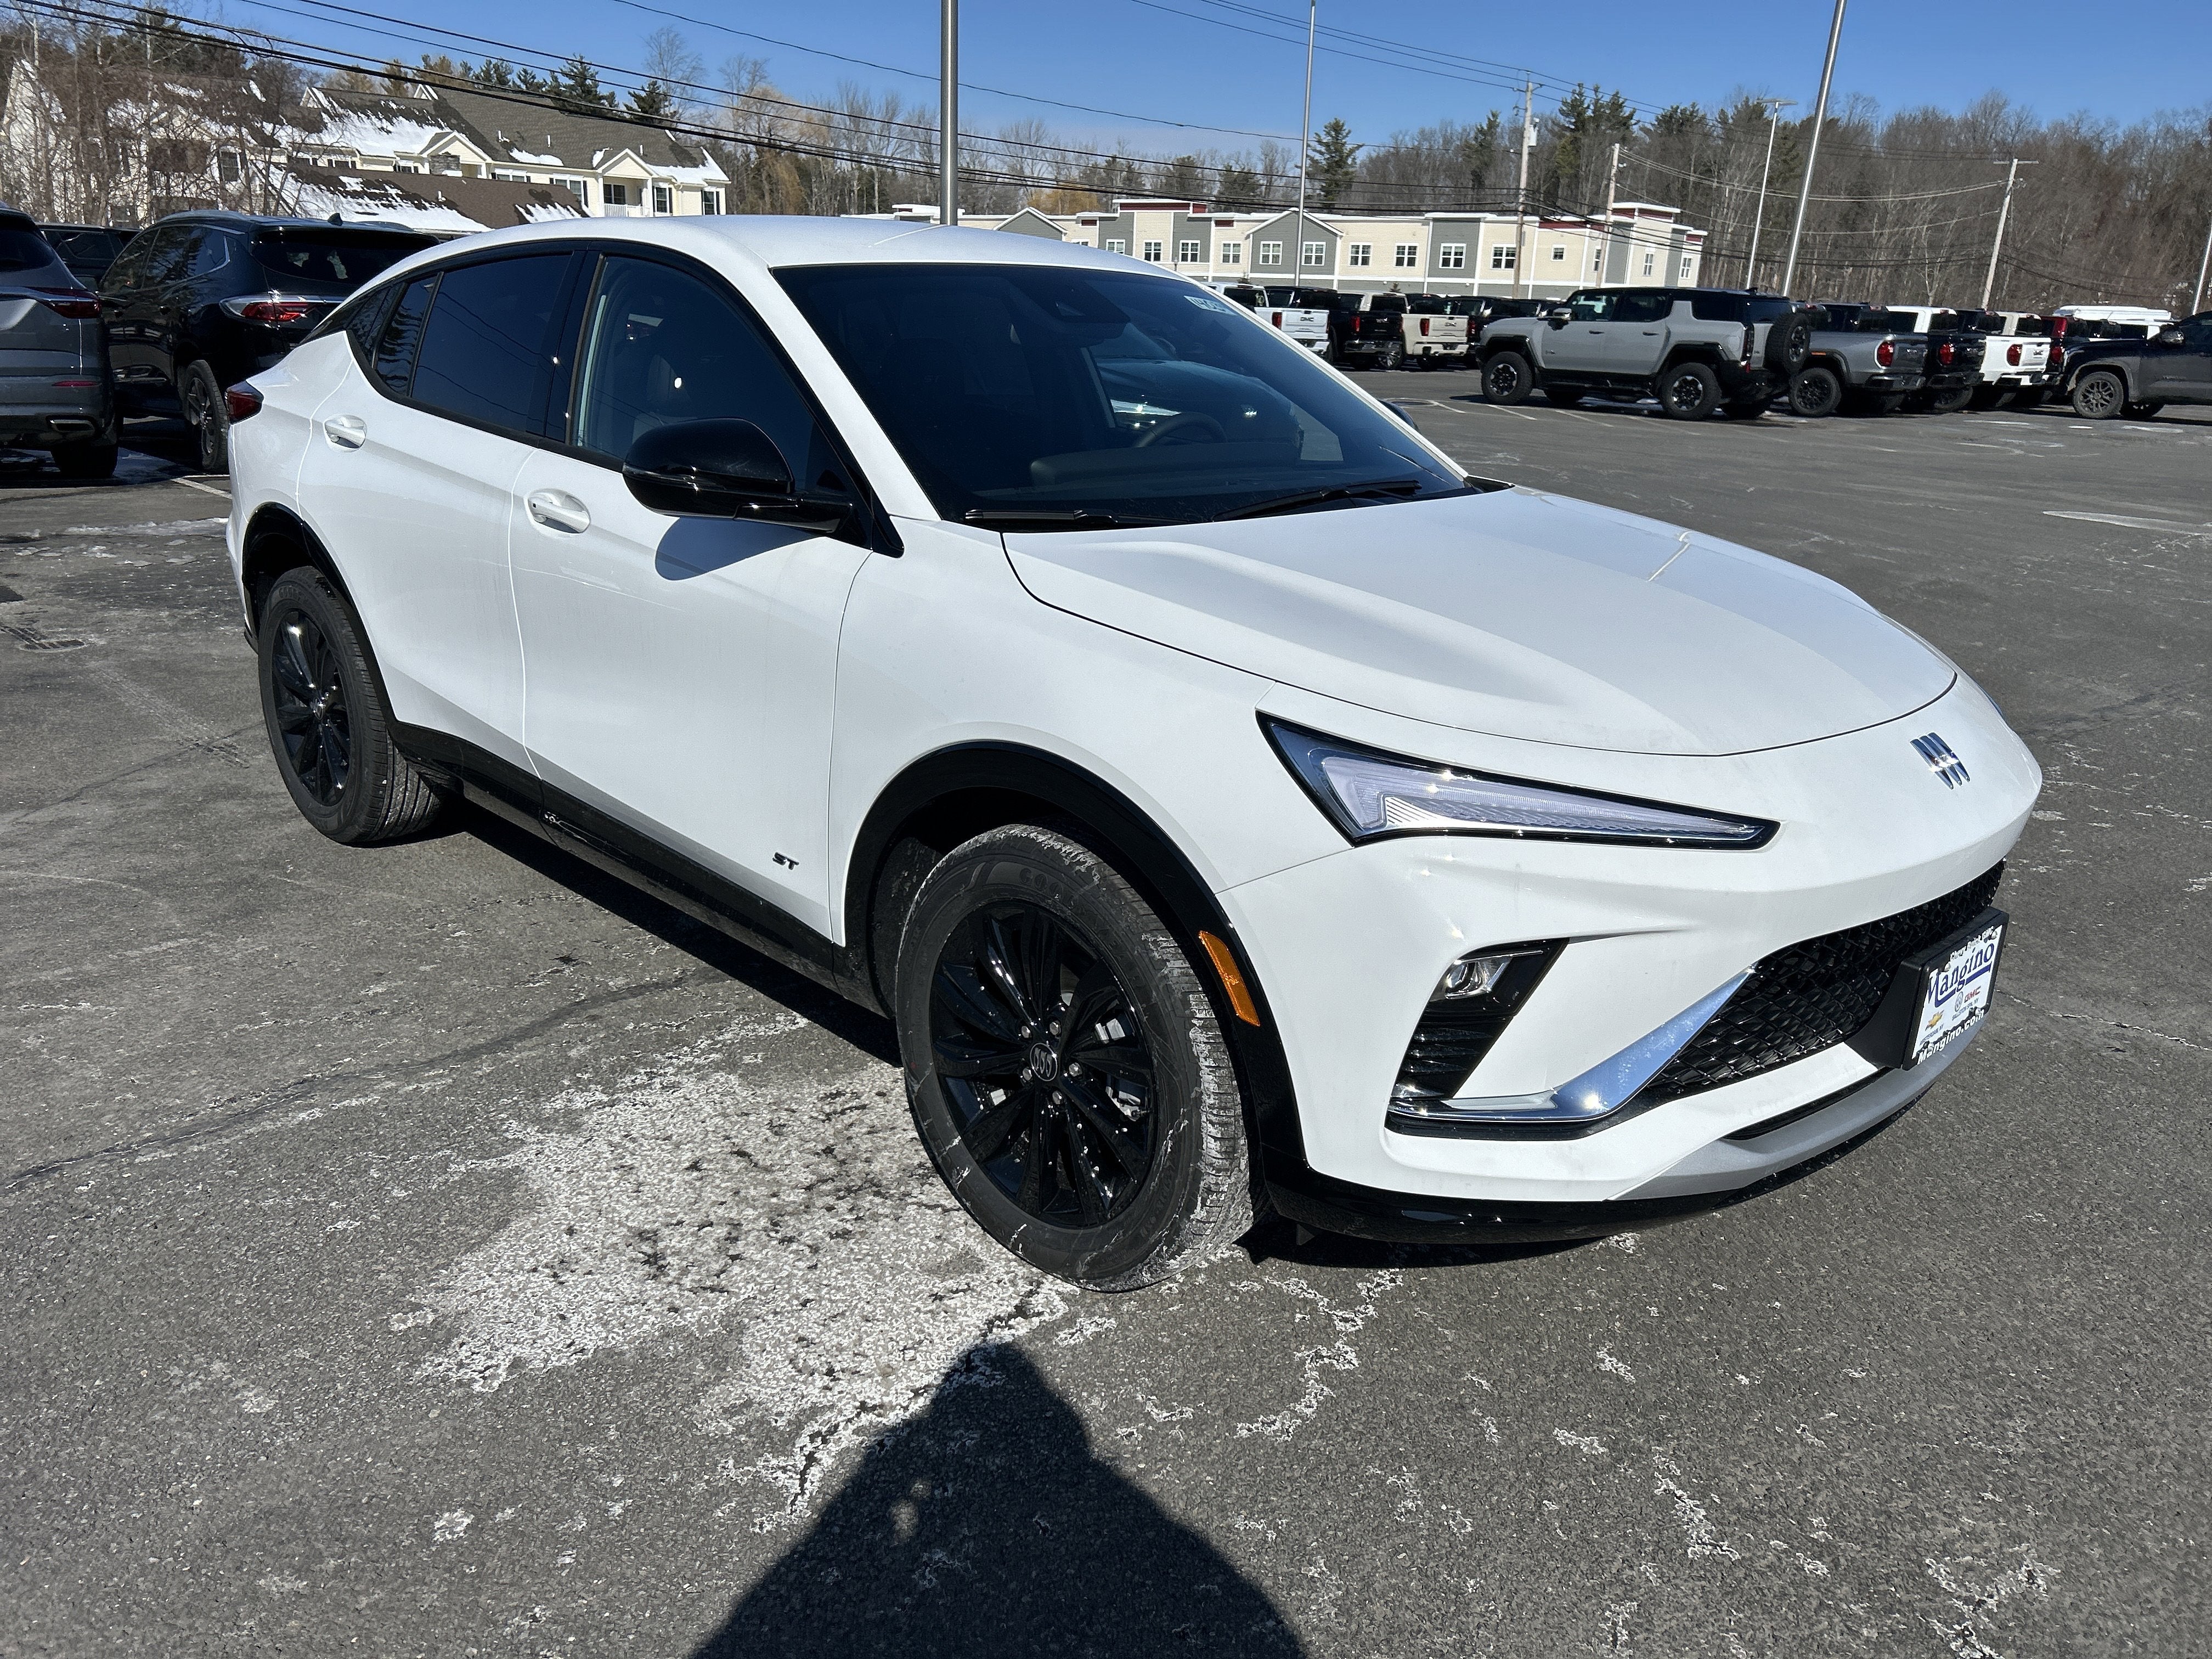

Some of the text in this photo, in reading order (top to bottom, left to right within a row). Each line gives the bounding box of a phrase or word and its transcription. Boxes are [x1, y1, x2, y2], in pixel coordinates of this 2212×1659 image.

[772, 852, 799, 870] ST
[1927, 943, 1995, 1007] Mangino
[1964, 986, 1981, 1003] GMC
[1917, 1009, 1984, 1065] Mangino.com
